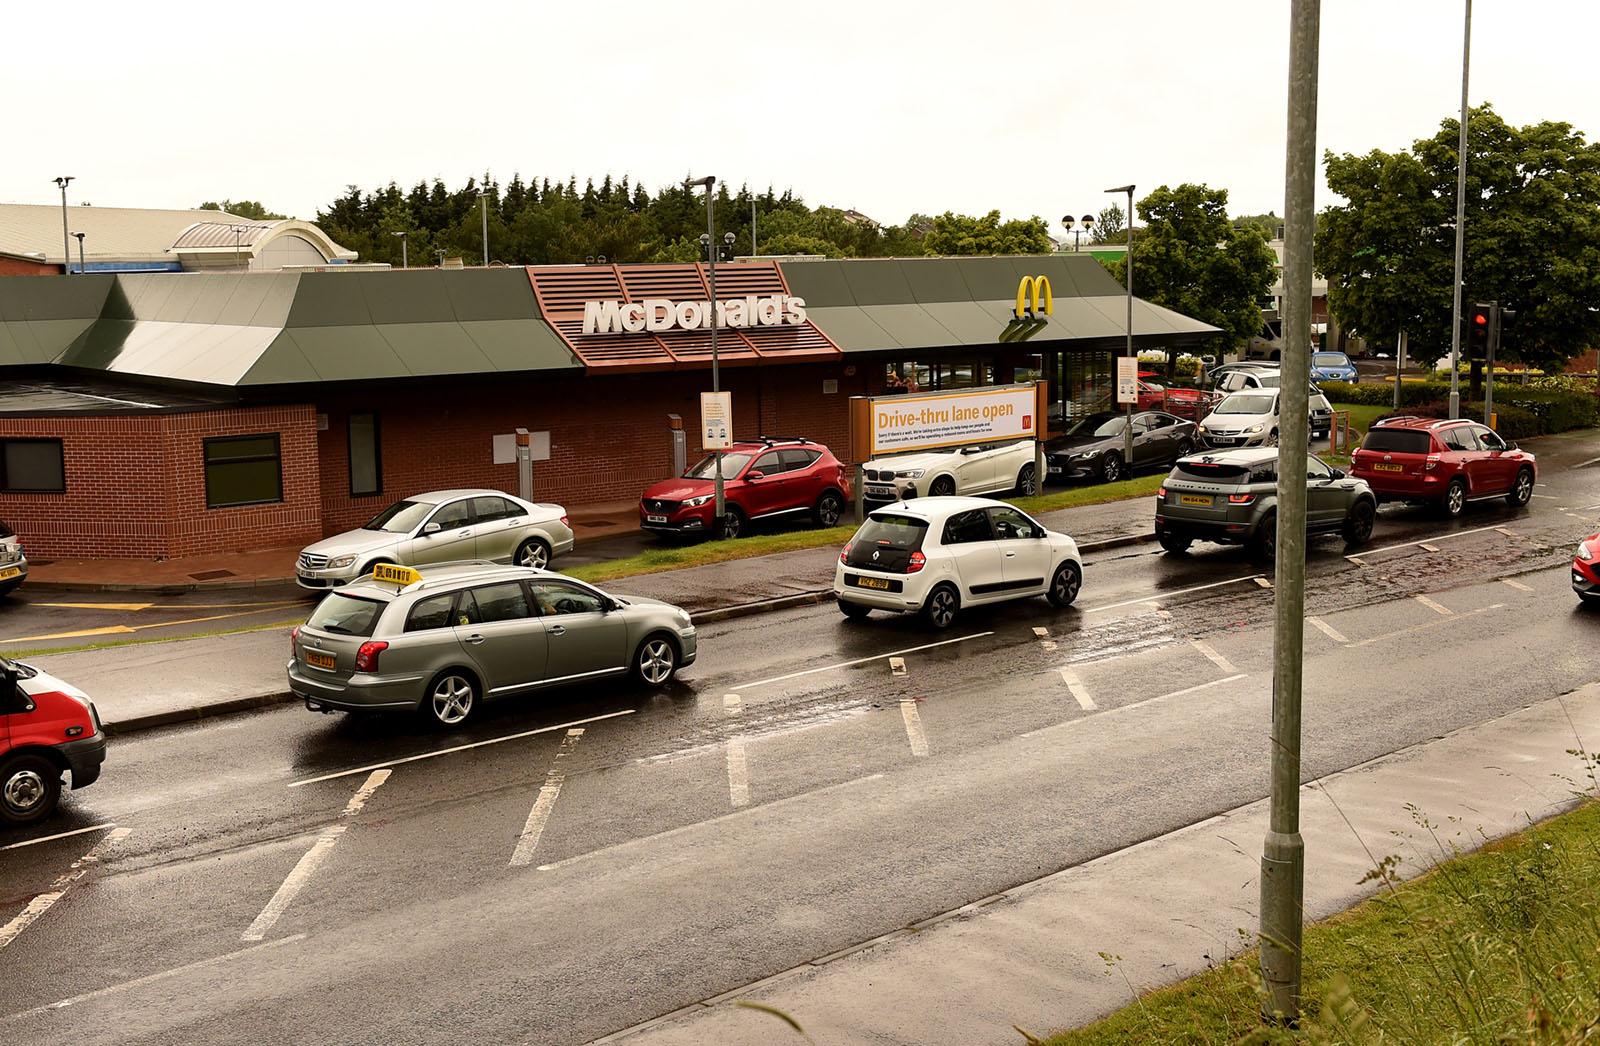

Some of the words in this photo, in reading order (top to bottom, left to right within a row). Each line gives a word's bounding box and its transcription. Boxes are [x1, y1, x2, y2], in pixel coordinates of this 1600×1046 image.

[582, 295, 806, 334] McDonald's
[879, 408, 948, 428] Drive-thru
[952, 406, 980, 421] lane
[982, 404, 1014, 422] open
